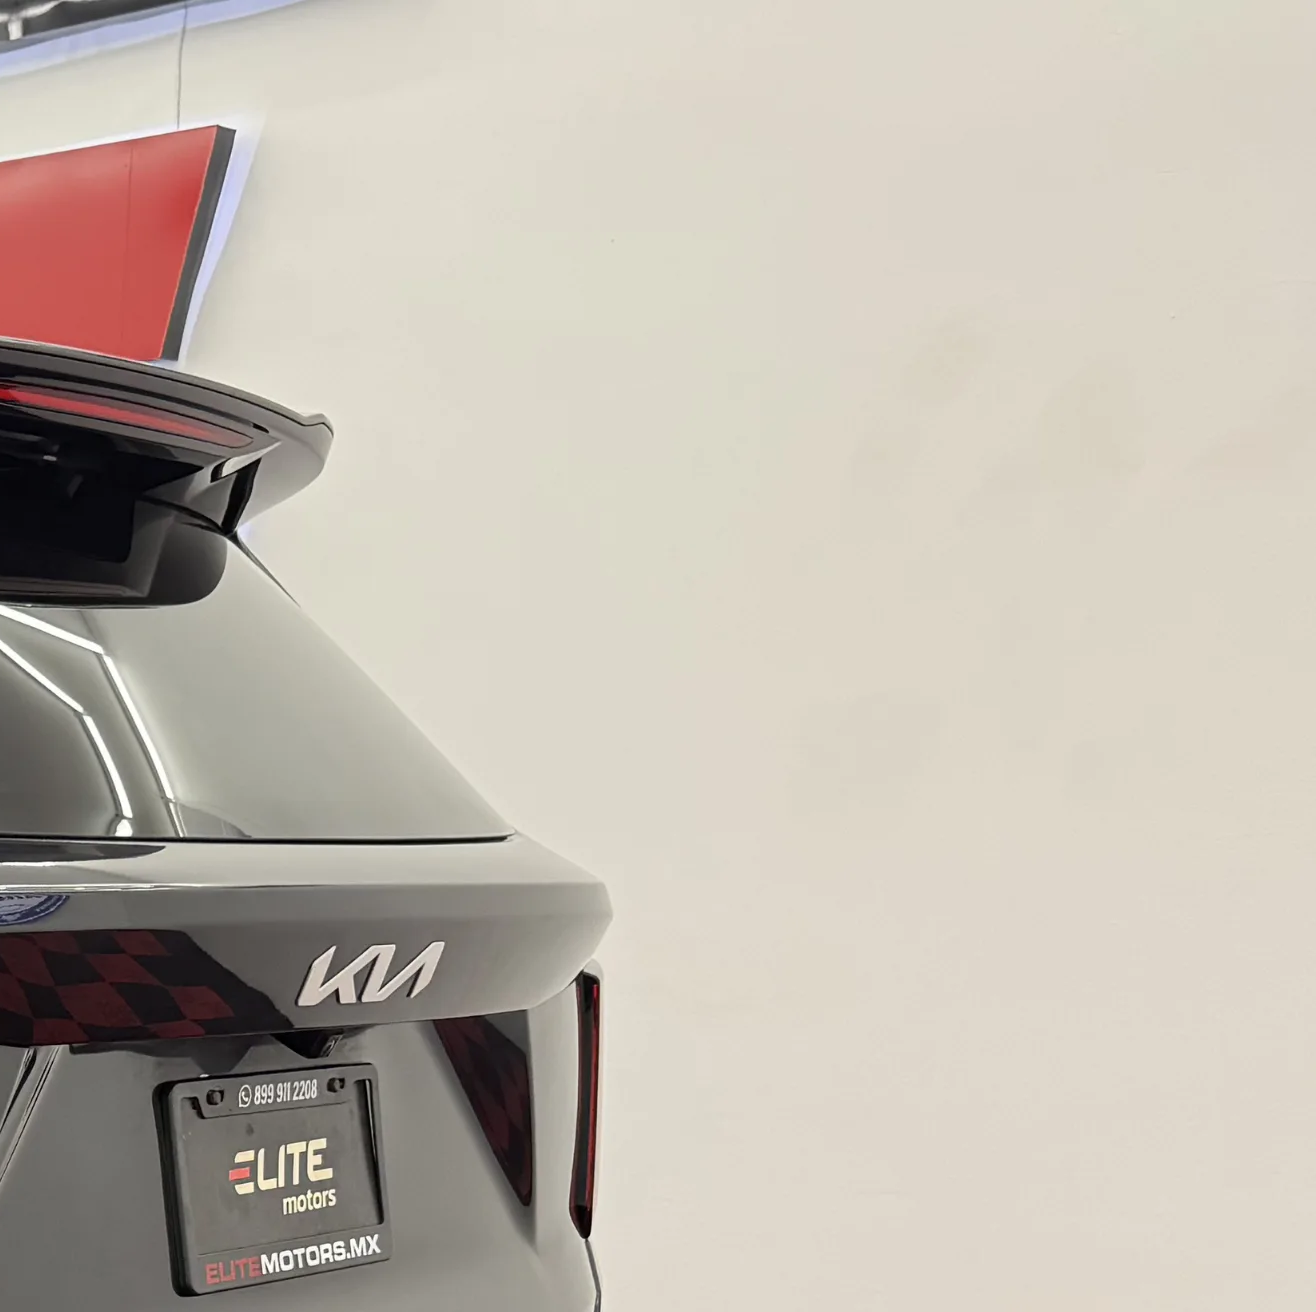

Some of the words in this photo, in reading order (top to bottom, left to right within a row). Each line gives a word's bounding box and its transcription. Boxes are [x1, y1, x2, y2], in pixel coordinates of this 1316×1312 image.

[296, 940, 446, 1007] KIA
[253, 1084, 275, 1106] 899
[276, 1081, 291, 1103] 911
[292, 1078, 318, 1101] 2208
[229, 1137, 334, 1196] ELITE
[282, 1188, 337, 1215] motors
[205, 1234, 382, 1285] ELITEMOTORS.MX
